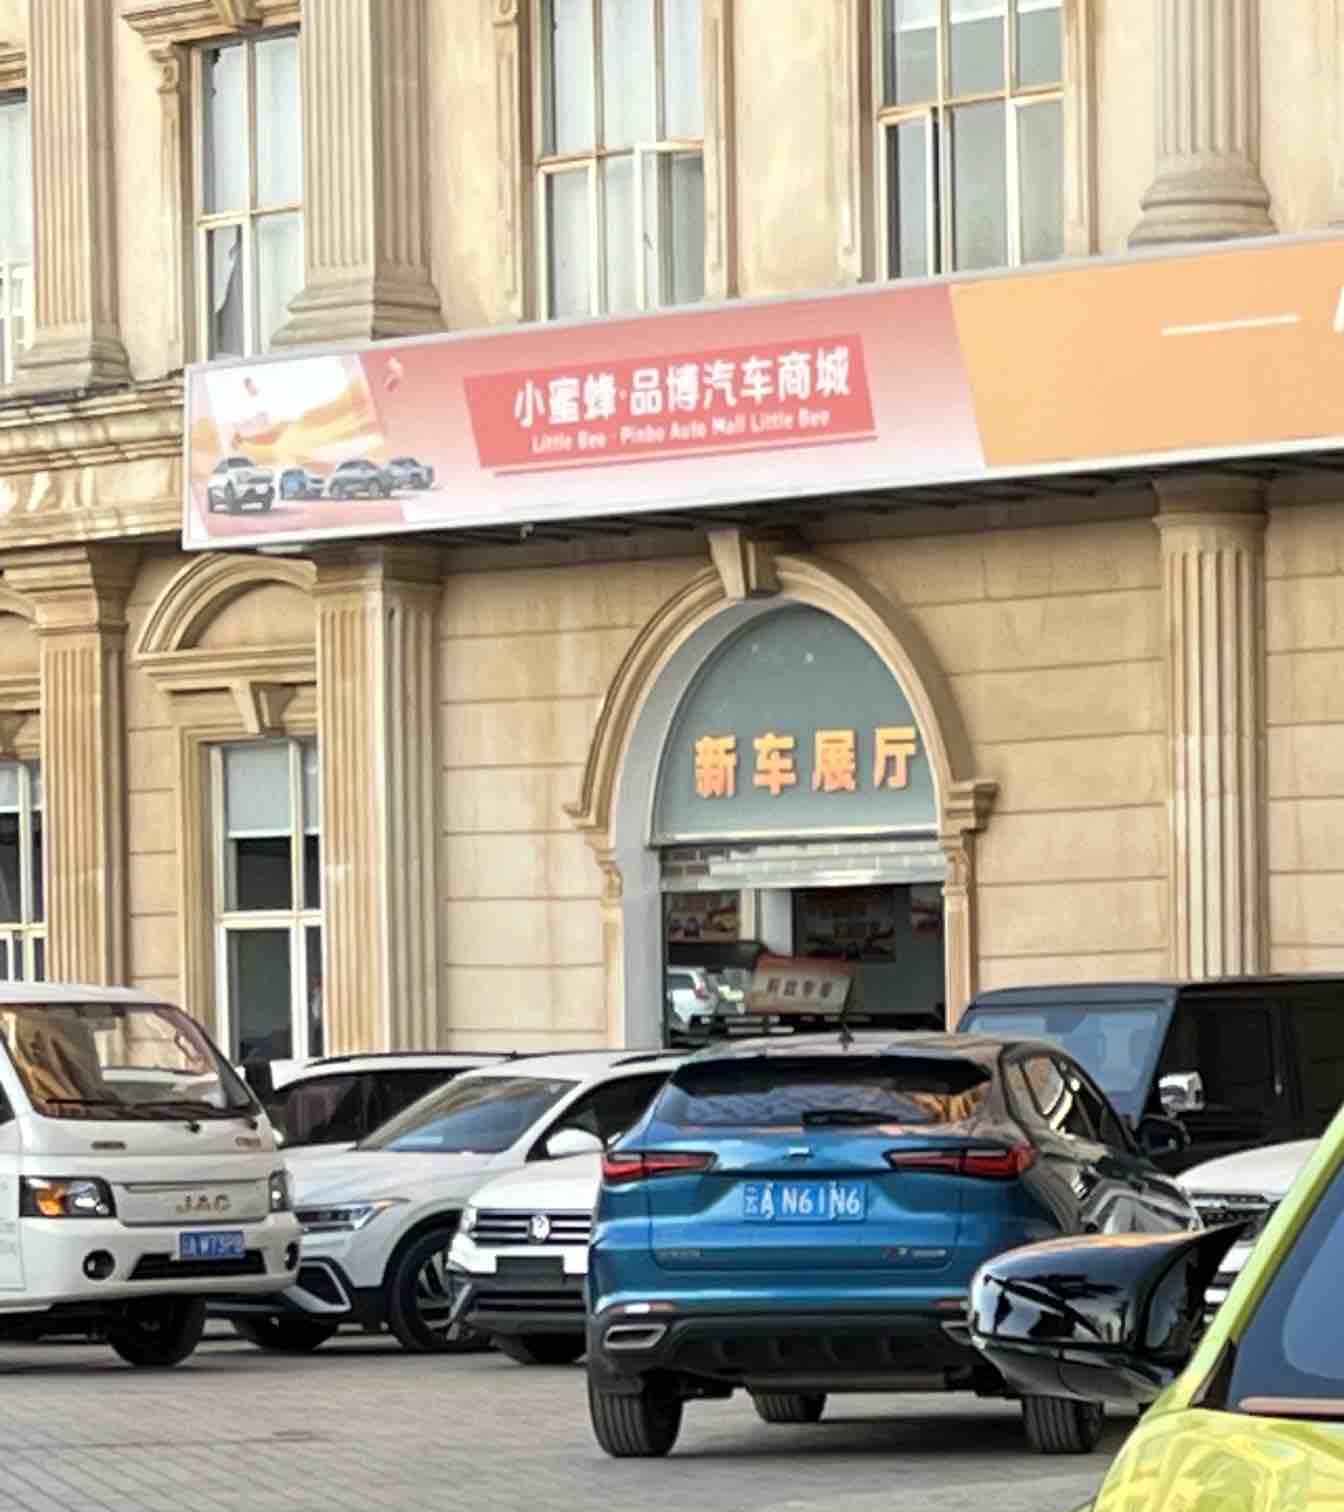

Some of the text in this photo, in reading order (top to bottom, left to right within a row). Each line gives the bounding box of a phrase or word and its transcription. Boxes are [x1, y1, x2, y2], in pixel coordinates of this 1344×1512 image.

[532, 432, 573, 454] Little
[577, 430, 607, 449] Bee
[669, 420, 706, 441] Auto
[711, 415, 746, 437] Mall
[750, 412, 793, 434] Little
[798, 407, 830, 428] Bee
[694, 725, 917, 799] 新车展厅
[175, 1194, 231, 1214] JAC
